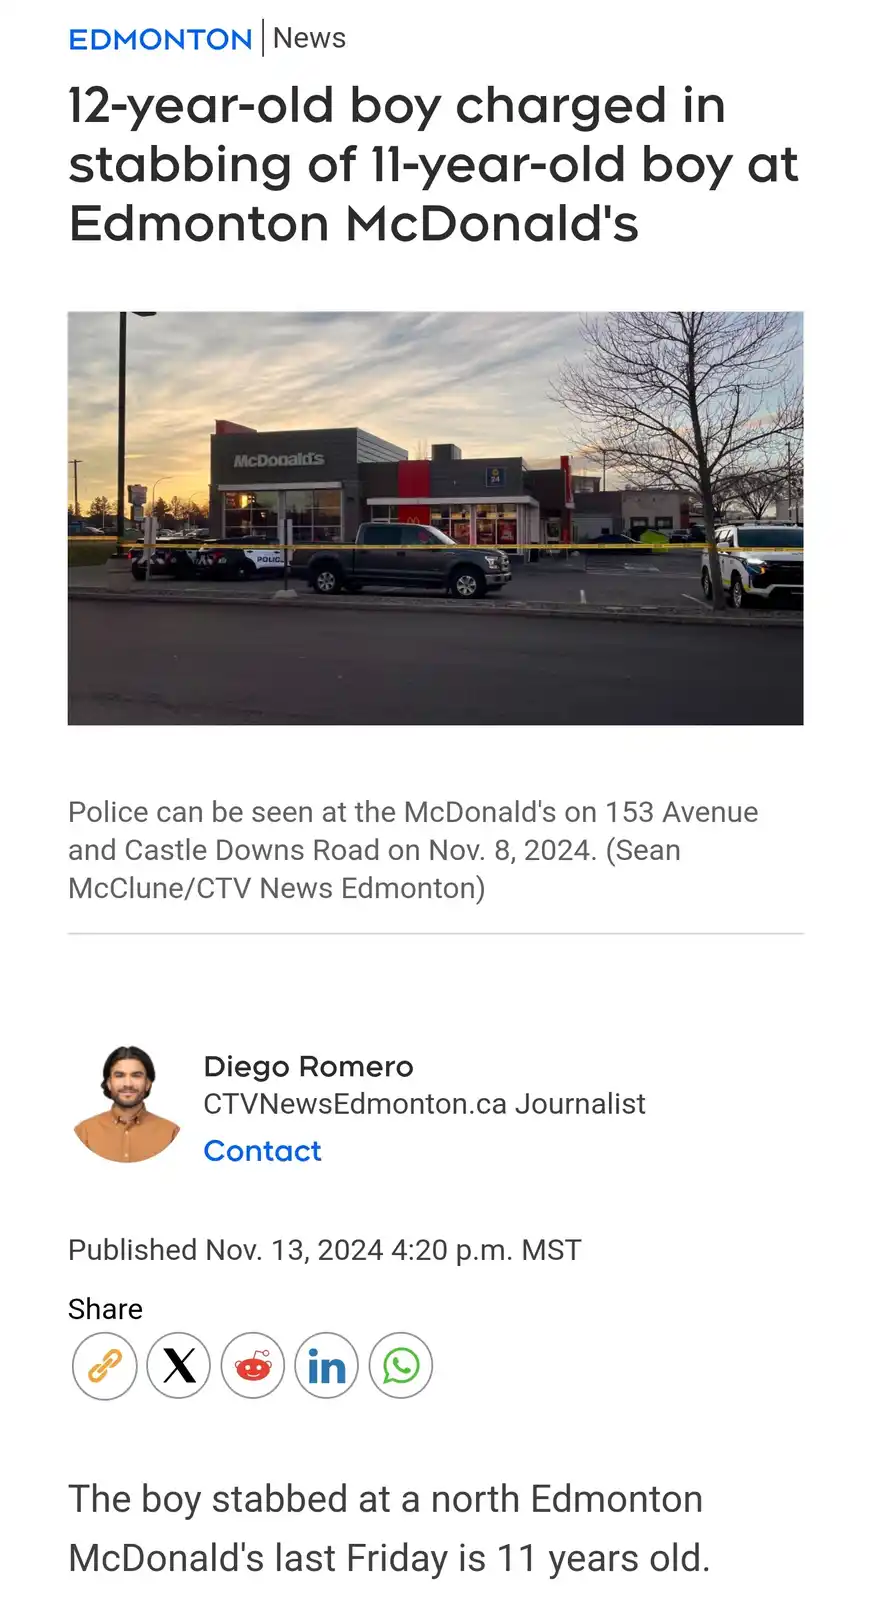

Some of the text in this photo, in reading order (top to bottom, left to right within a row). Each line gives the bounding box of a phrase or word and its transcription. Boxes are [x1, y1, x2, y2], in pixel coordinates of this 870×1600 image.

[70, 27, 346, 50] EDMONTON News
[69, 85, 725, 132] 12-year-old boy charged in
[69, 145, 800, 191] stabbing of 11-year-old boy at
[71, 204, 639, 242] Edmonton McDonald's
[234, 452, 325, 468] McDonald's
[69, 800, 759, 823] Police can be seen at the McDonald's on 153 Avenue
[68, 837, 680, 868] and Castle Downs Road on Nov. 8, 2024. (Sean
[69, 875, 485, 906] McClune/CTV News Edmonton)
[204, 1055, 414, 1083] Diego Romero
[204, 1092, 646, 1115] CTVNewsEdmonton.ca Journalist
[204, 1140, 322, 1162] Contact
[69, 1238, 583, 1267] Published Nov. 13, 2024 4:20 p.m. MST
[68, 1297, 143, 1320] Share
[68, 1483, 702, 1521] The boy stabbed at a north Edmonton
[70, 1542, 710, 1580] McDonald's last Friday is 11 years old.
